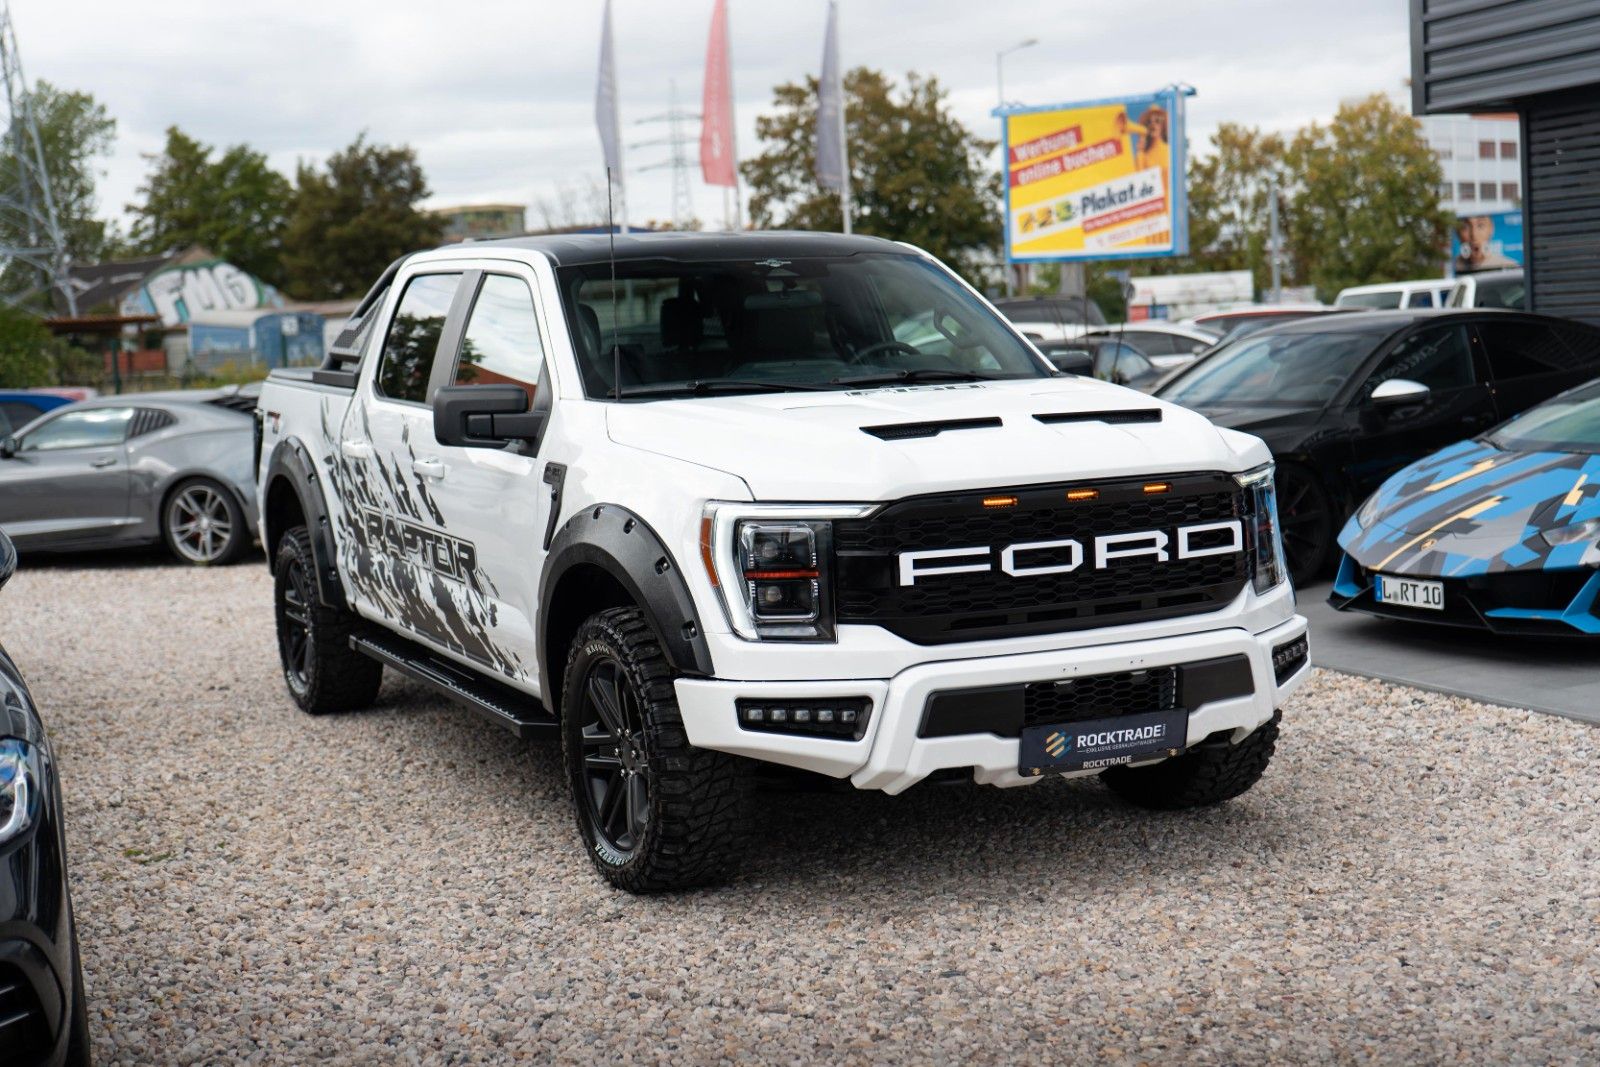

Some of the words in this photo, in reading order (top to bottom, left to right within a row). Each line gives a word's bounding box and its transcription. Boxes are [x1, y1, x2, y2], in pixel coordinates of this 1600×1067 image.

[1014, 130, 1078, 161] Werbung
[1017, 159, 1062, 186] online
[1062, 141, 1118, 171] buchen
[363, 509, 484, 595] RAPTOR
[899, 520, 1243, 586] FORD
[1076, 724, 1162, 748] ROCKTRADE
[1082, 755, 1132, 769] ROCKTRADE
